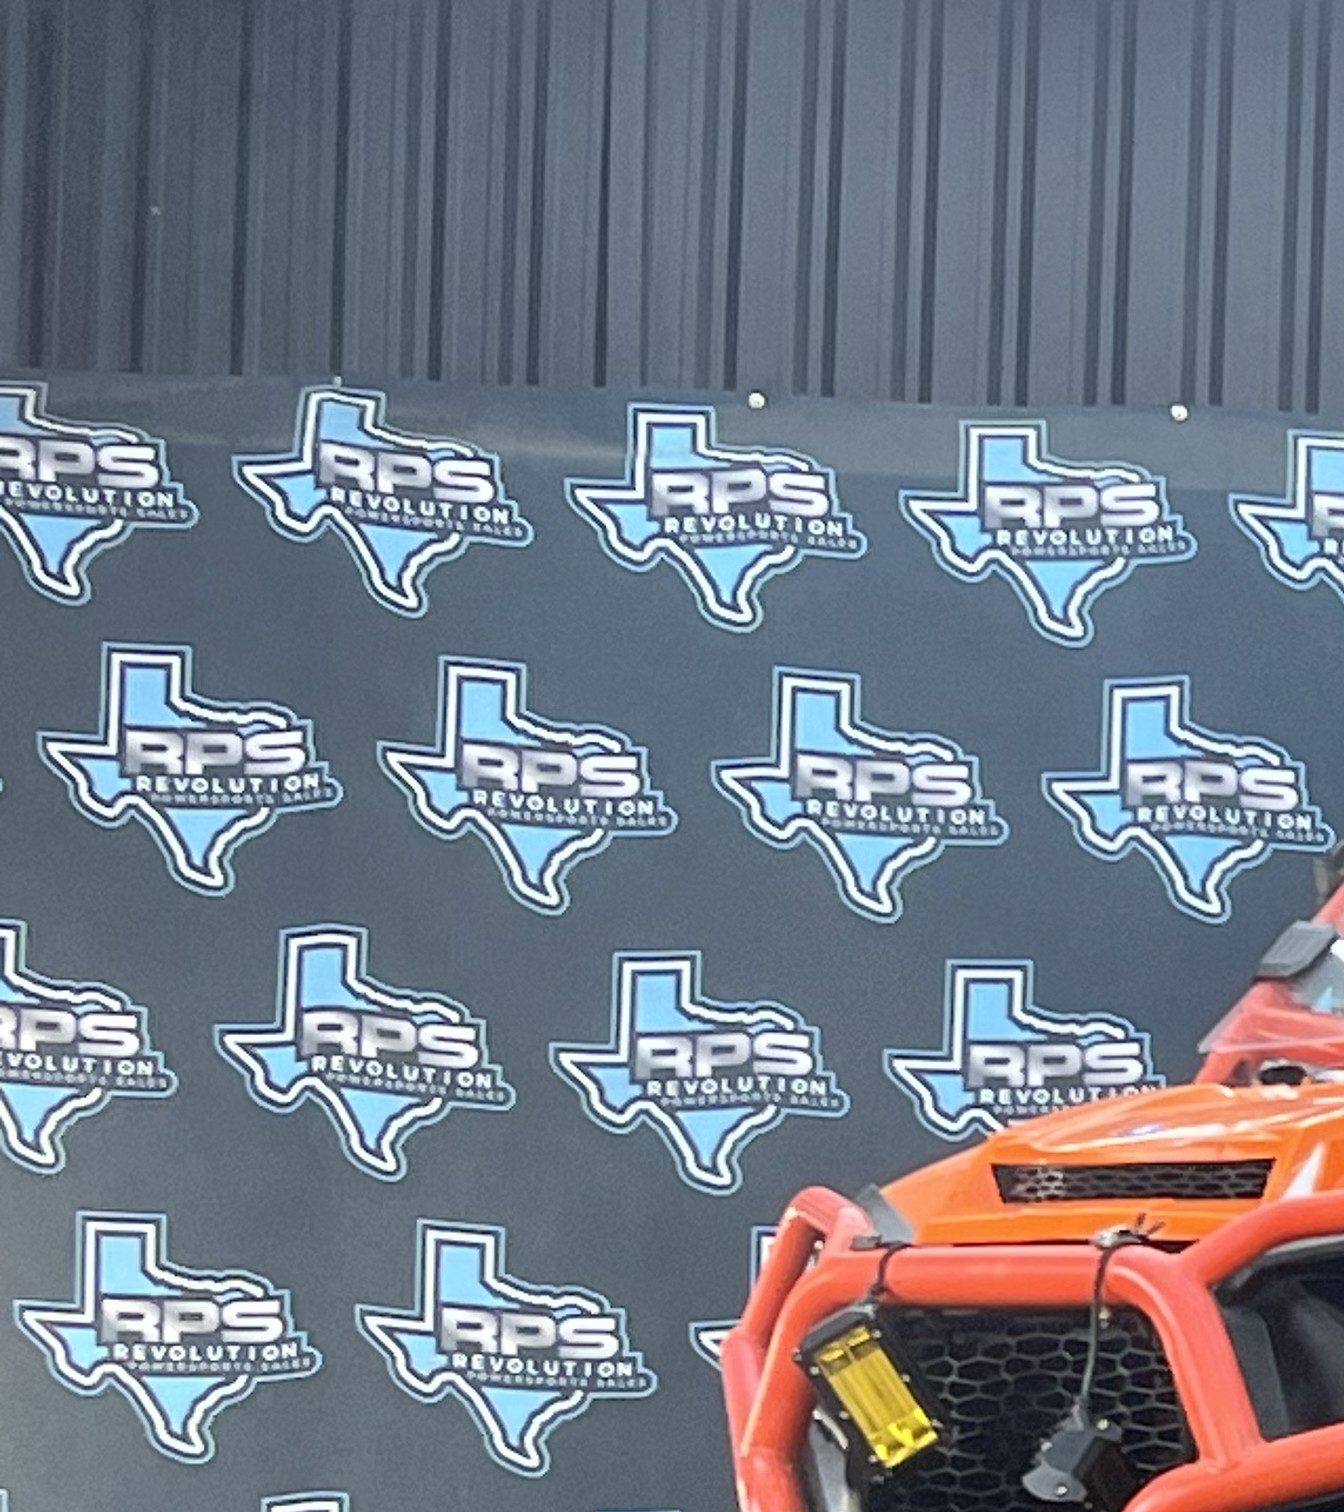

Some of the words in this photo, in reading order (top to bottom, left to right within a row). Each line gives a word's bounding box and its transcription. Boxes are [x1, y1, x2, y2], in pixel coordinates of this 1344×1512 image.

[0, 479, 174, 507] EVOLUTION
[318, 439, 493, 507] RPS
[331, 487, 509, 523] REVOLUTION
[651, 470, 828, 518] RPS
[984, 484, 1158, 530] RPS
[664, 515, 843, 535] REVOLUTION
[996, 526, 1173, 545] REVOLUTION
[125, 730, 305, 775] RPS
[462, 743, 639, 800] RPS
[136, 773, 319, 792] REVOLUTION
[796, 753, 971, 809] RPS
[1126, 759, 1298, 814] RPS
[473, 789, 654, 814] REVOLUTION
[807, 799, 985, 824] REVOLUTION
[1137, 805, 1311, 830] REVOLUTION
[0, 1001, 139, 1060] PS
[301, 1008, 478, 1072] RPS
[0, 1048, 153, 1076] VOLUTION
[313, 1054, 492, 1088] REVOLUTION
[635, 1033, 812, 1081] RPS
[968, 1043, 1142, 1088] RPS
[647, 1077, 826, 1096] REVOLUTION
[101, 1298, 282, 1343] RPS
[440, 1307, 618, 1361] RPS
[113, 1343, 297, 1360] REVOLUTION
[452, 1353, 633, 1376] REVOLUTION
